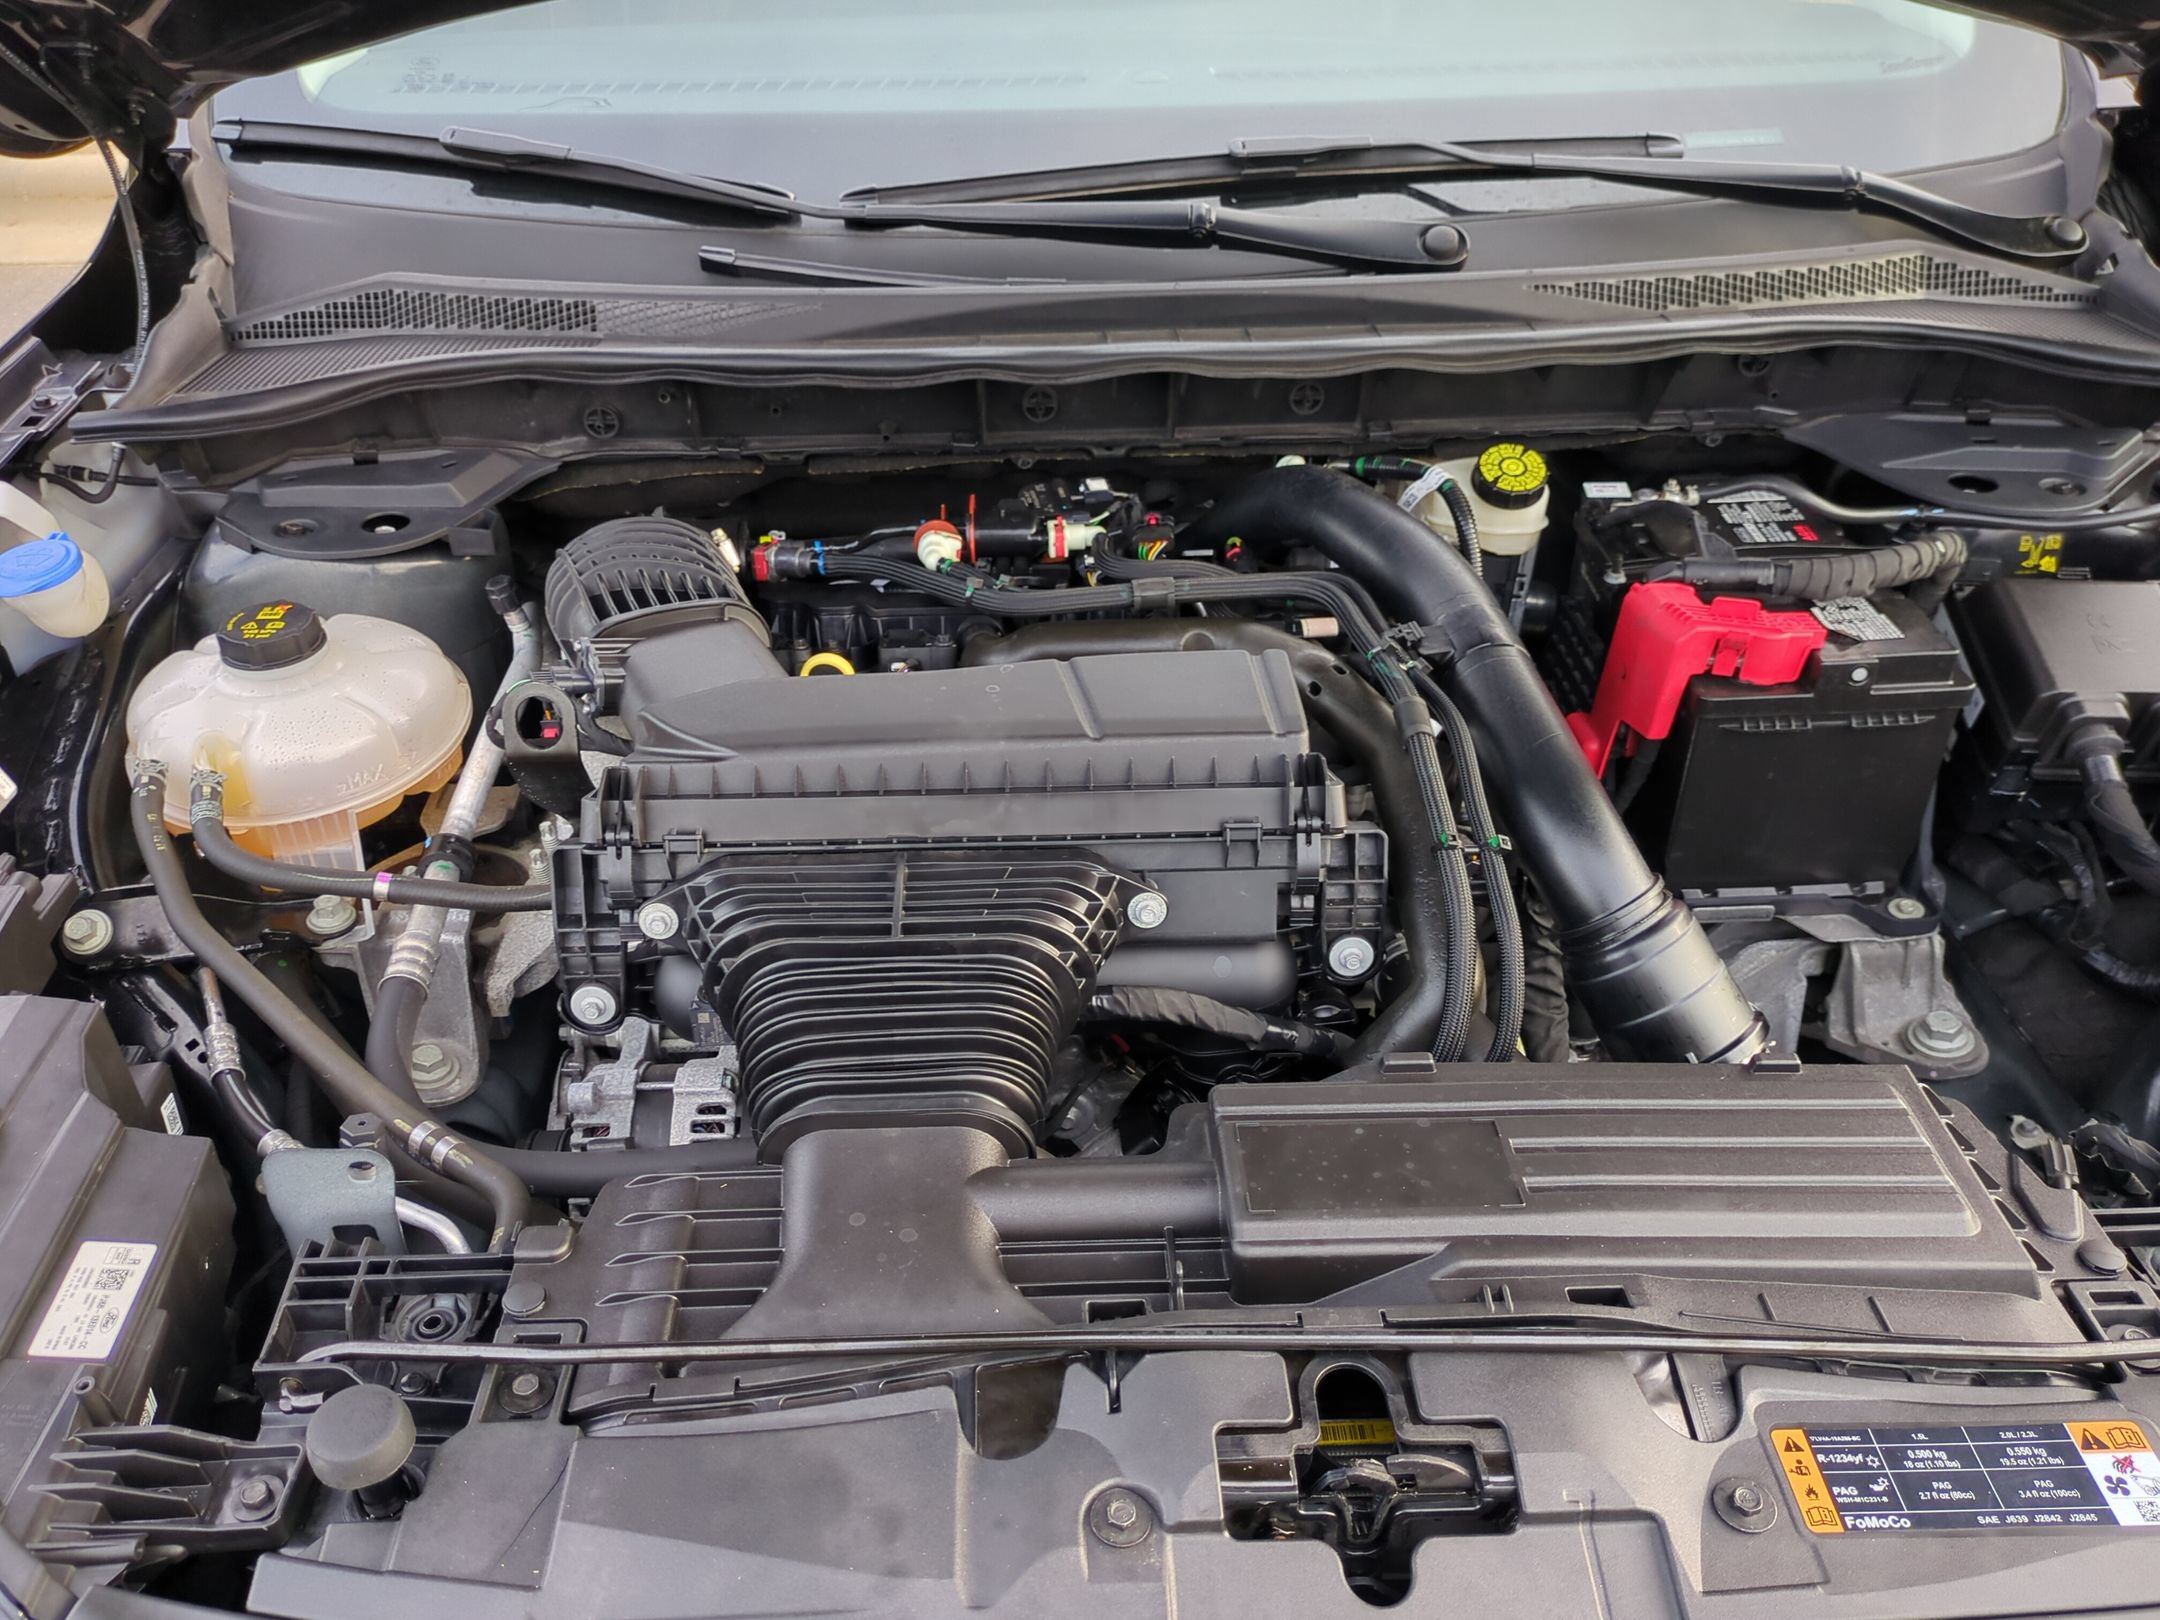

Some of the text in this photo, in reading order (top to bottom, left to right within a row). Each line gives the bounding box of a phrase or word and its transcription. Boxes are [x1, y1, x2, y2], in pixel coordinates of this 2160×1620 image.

[1907, 1449, 1948, 1460] 0.500 kg
[2006, 1446, 2047, 1457] 0.550 kg
[1816, 1453, 1863, 1465] R-1234yf
[1903, 1460, 1914, 1468] 18
[1925, 1460, 1944, 1469] (1.10
[1945, 1459, 1961, 1469] lbs)
[2000, 1458, 2016, 1466] 19.5
[2028, 1457, 2047, 1466] (1.21
[2048, 1456, 2065, 1466] lbs)
[1932, 1481, 1952, 1489] PAG
[2034, 1480, 2054, 1488] PAG
[1832, 1486, 1858, 1496] PAG
[2019, 1490, 2032, 1498] 3.4
[2052, 1489, 2080, 1499] (100cc)
[1844, 1515, 1911, 1529] FoMoCo
[1977, 1514, 2098, 1524] SAE J639 J2842 J2845
